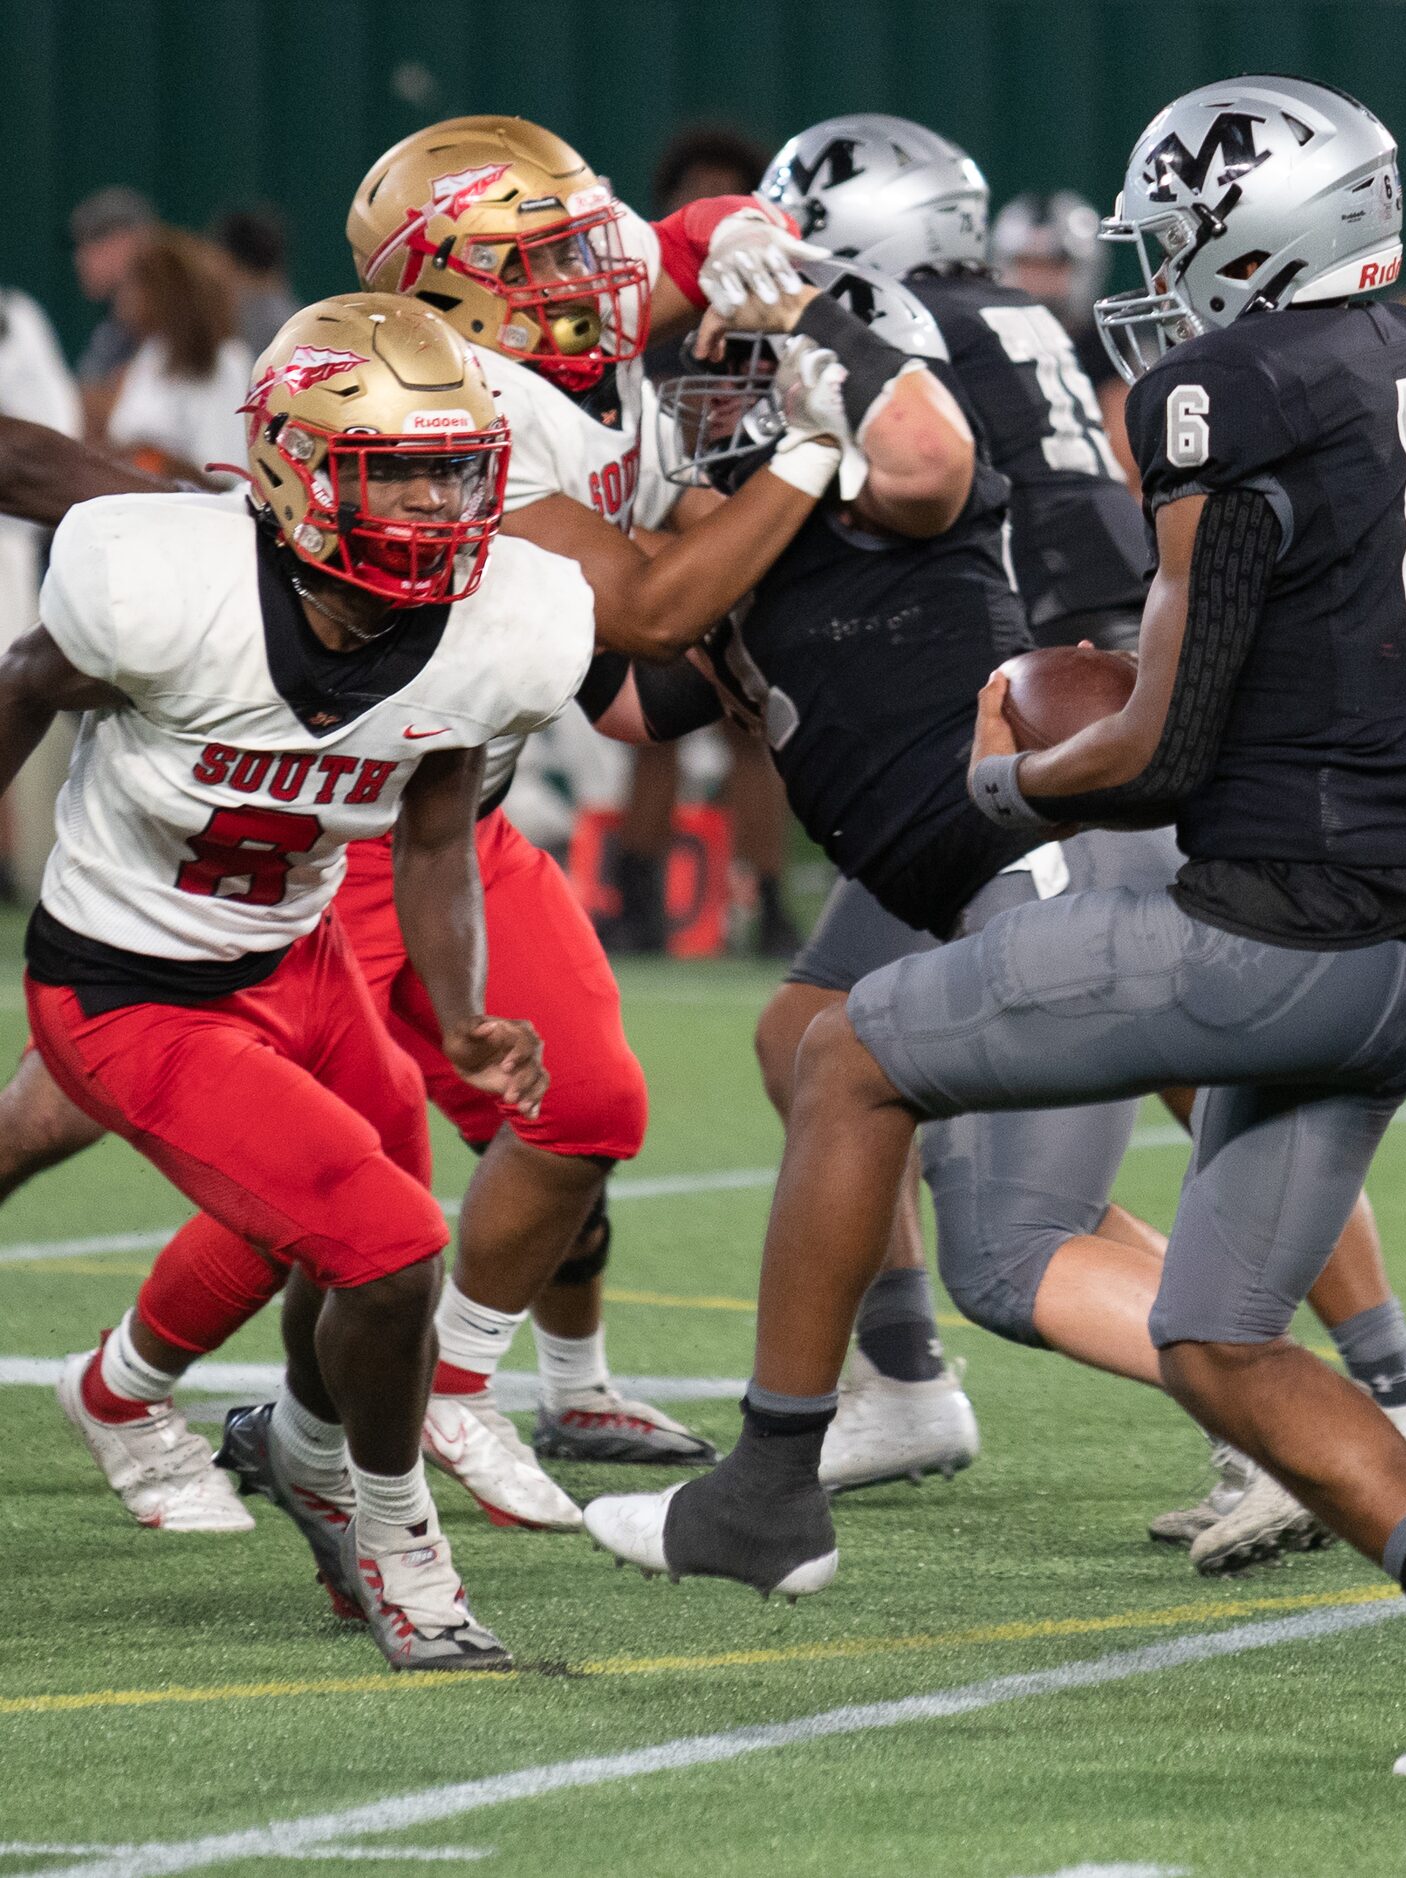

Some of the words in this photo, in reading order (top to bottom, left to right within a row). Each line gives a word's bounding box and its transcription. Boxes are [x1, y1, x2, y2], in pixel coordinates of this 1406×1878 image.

[768, 138, 866, 201] M
[1143, 112, 1272, 202] M
[1383, 174, 1393, 200] 6
[414, 415, 468, 429] Riddell
[1166, 384, 1210, 468] 6
[192, 742, 400, 805] SOUTH
[174, 804, 325, 907] 8
